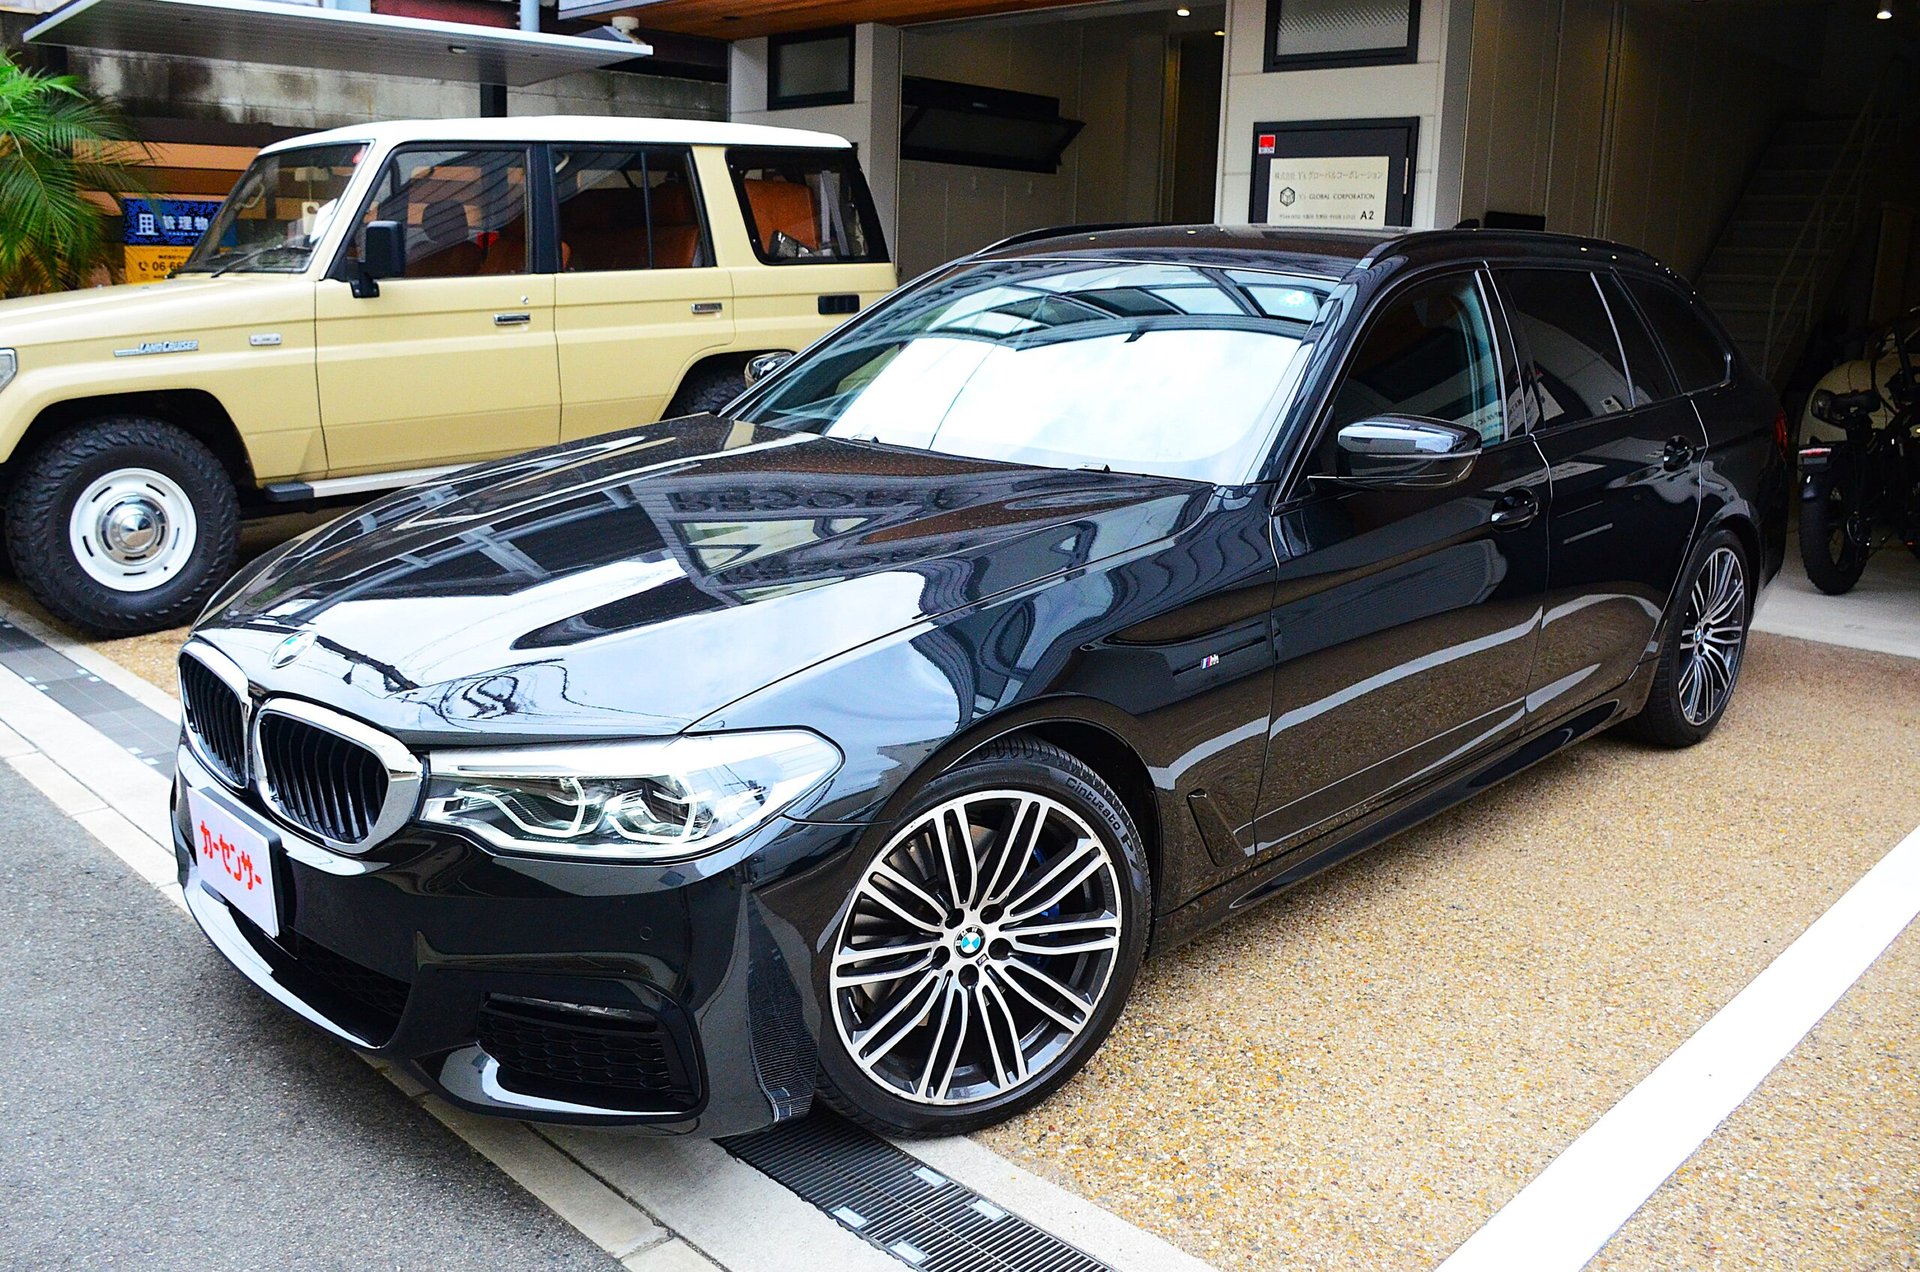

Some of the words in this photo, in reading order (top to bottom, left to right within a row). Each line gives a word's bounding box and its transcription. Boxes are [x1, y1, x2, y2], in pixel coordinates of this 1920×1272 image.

[1360, 210, 1375, 220] A2
[200, 819, 263, 891] カーセンサー
